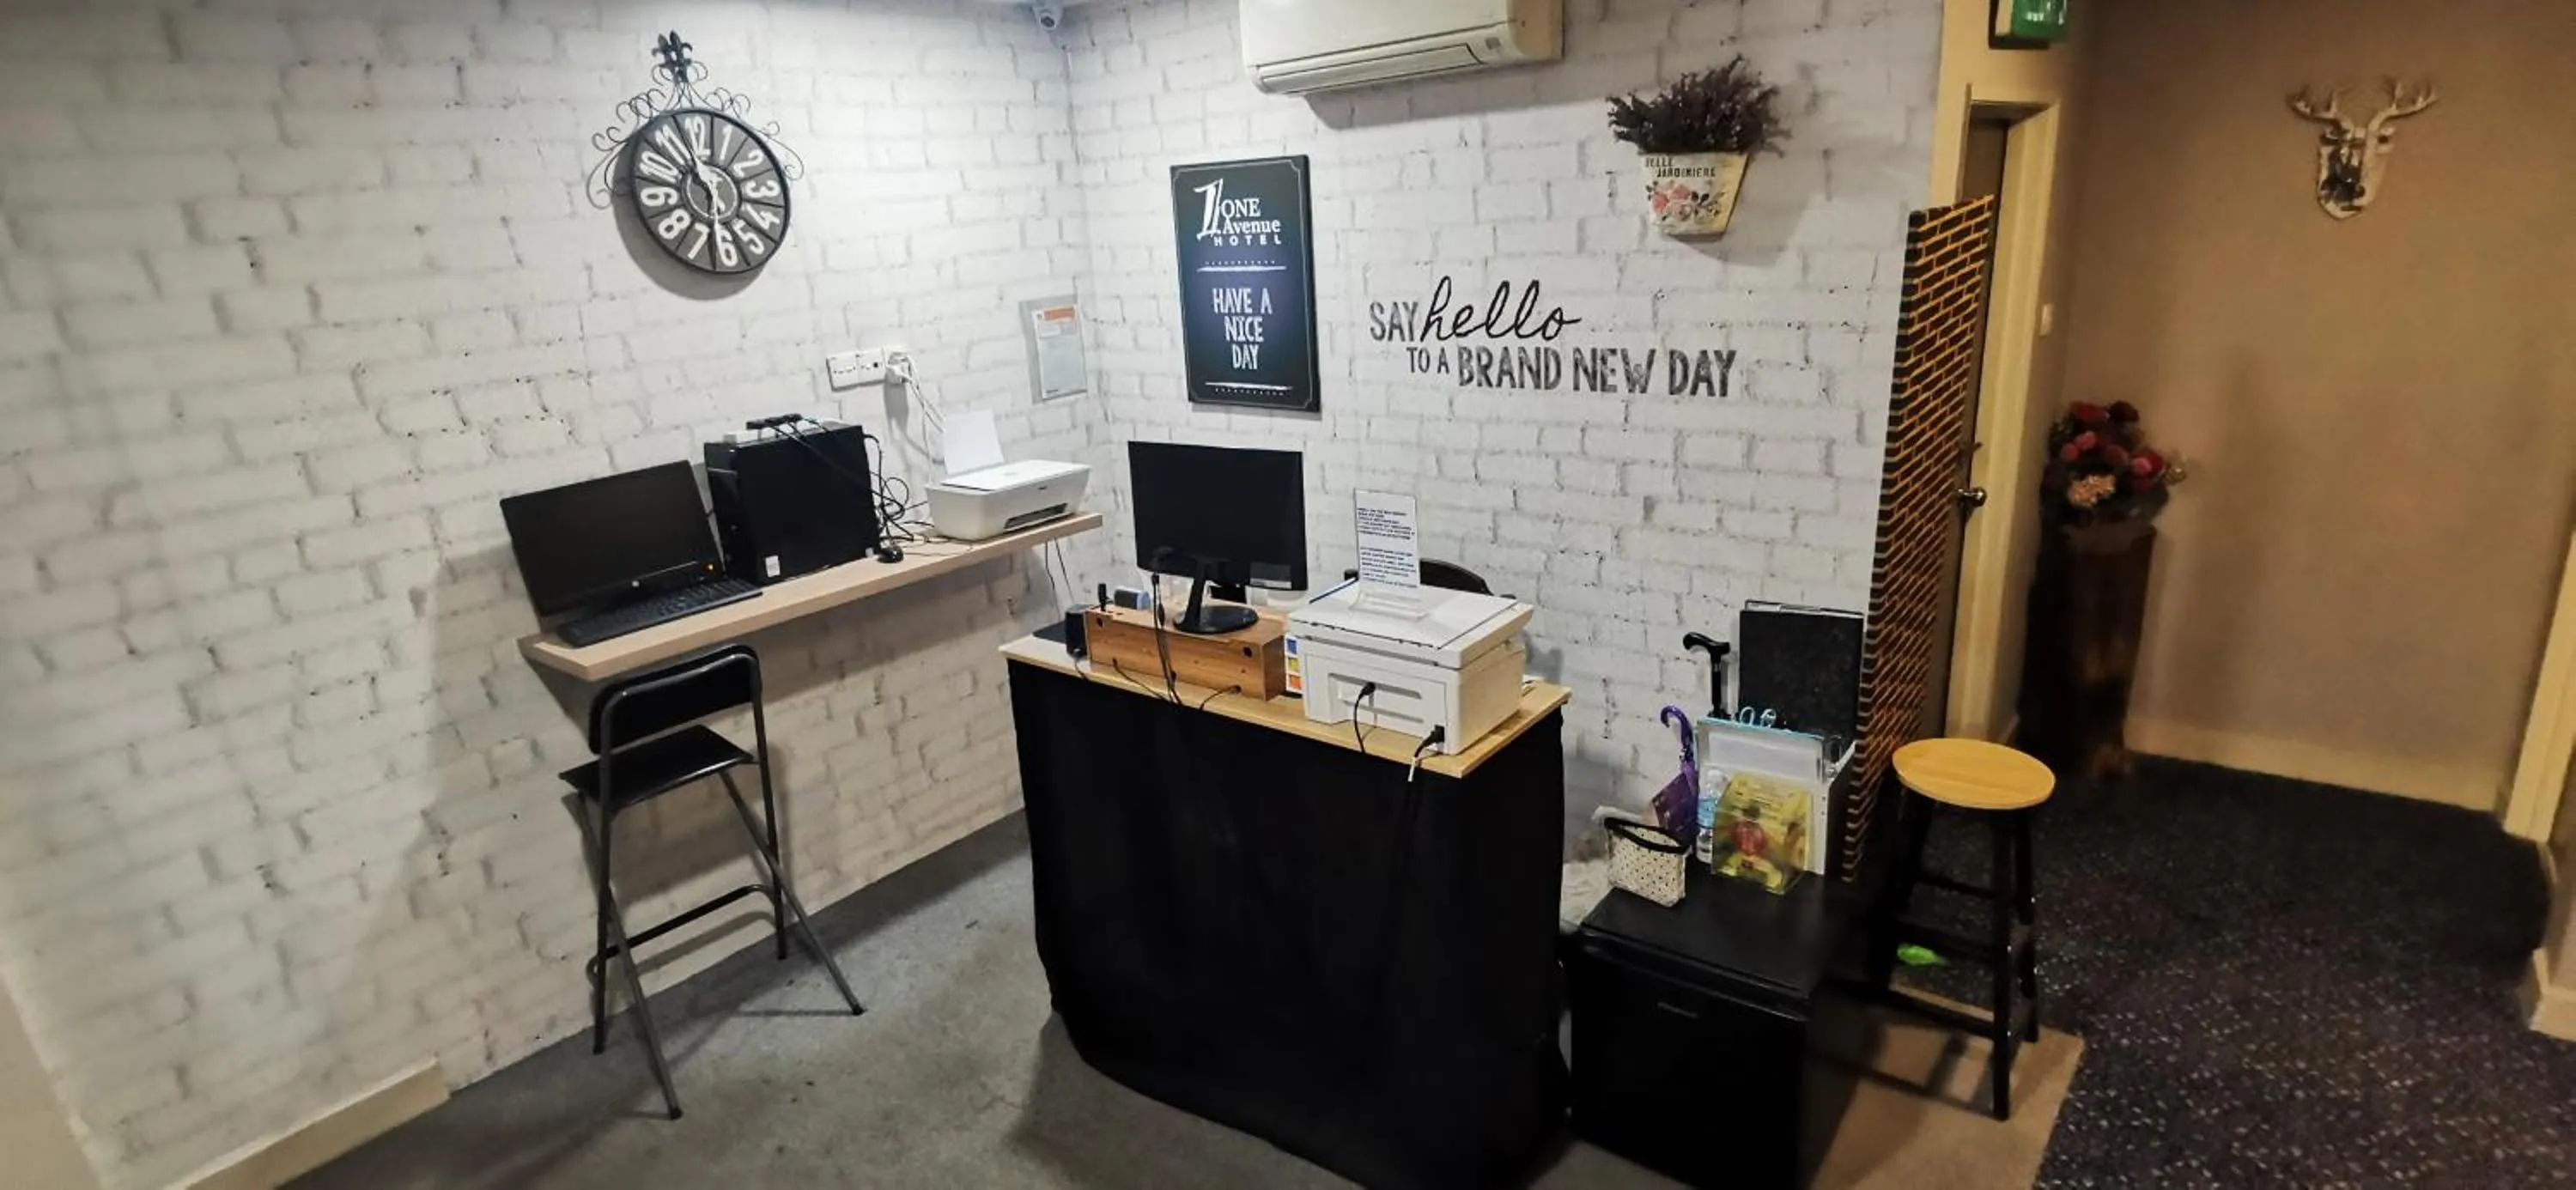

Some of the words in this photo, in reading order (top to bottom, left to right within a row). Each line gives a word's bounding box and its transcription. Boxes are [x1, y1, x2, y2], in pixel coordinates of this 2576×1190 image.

[654, 124, 692, 165] 11
[685, 116, 711, 158] 12
[721, 124, 732, 161] 1
[640, 151, 681, 184] 10
[732, 149, 763, 178] 2
[641, 186, 678, 207] 9
[745, 180, 781, 197] 3
[741, 203, 781, 229] 4
[1220, 198, 1261, 218] ONE
[659, 209, 690, 240] 8
[732, 218, 765, 255] 5
[1223, 218, 1281, 234] Avenue
[687, 223, 710, 259] 7
[716, 224, 738, 267] 6
[1213, 234, 1282, 246] HOTEL
[1212, 288, 1253, 314] HAVE
[1261, 288, 1273, 314] A
[1370, 301, 1419, 342] SAY
[1420, 276, 1582, 342] hello
[1224, 315, 1264, 342] NICE
[1232, 343, 1260, 370] DAY
[1406, 347, 1431, 373] TO
[1437, 348, 1449, 374] A
[1459, 347, 1563, 391] BRAND
[1572, 348, 1657, 394] NEW
[1668, 349, 1737, 397] DAY
